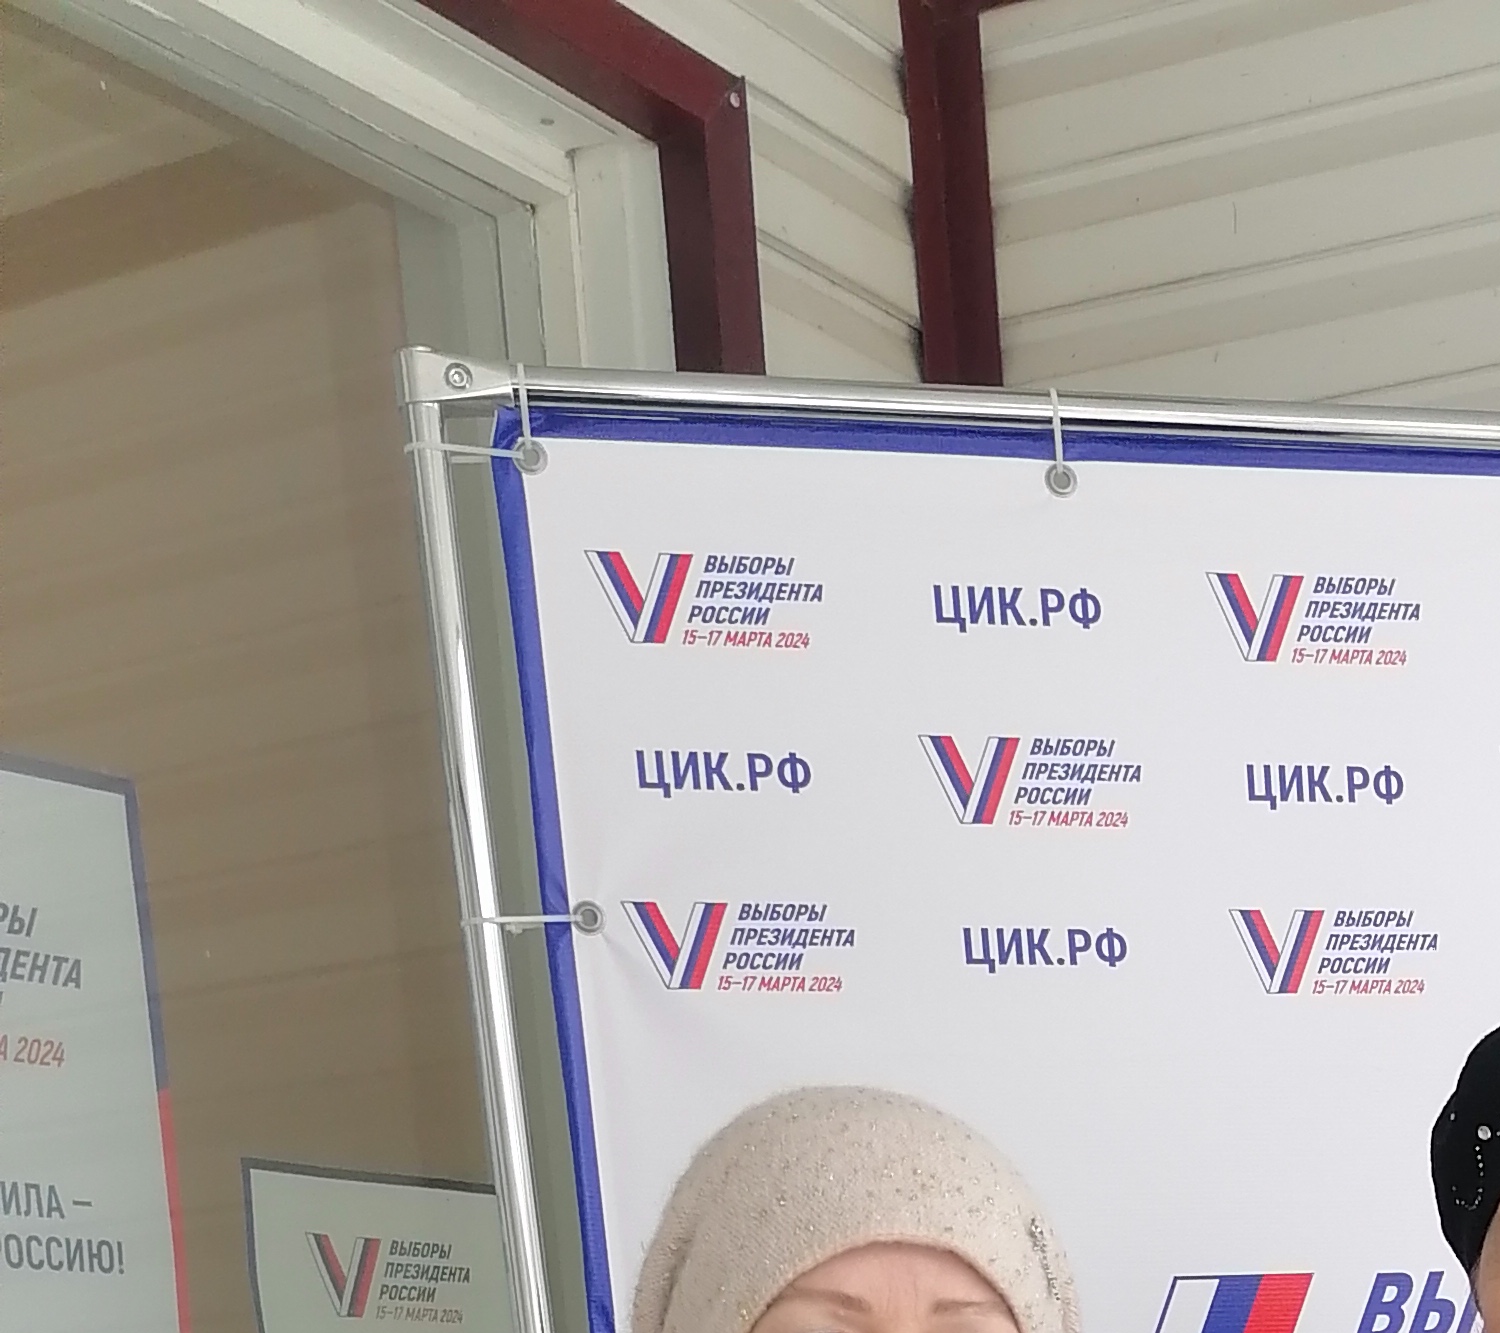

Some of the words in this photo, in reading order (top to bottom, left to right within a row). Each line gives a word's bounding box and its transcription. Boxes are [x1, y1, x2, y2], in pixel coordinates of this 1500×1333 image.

[704, 555, 794, 575] ВЫБОРЫ
[696, 580, 822, 603] ПРЕЗИДЕНТА
[1313, 577, 1395, 595] ВЫБОРЫ
[688, 605, 770, 625] РОССИИ
[933, 585, 1101, 633] ЦИК.РФ
[1305, 601, 1420, 622] ПРЕЗИДЕНТА
[724, 631, 772, 647] МАРТА
[775, 632, 809, 648] 2024
[1297, 625, 1372, 643] РОССИИ
[1329, 649, 1373, 664] МАРТА
[1375, 650, 1406, 665] 2024
[1030, 738, 1115, 757] ВЫБОРЫ
[636, 750, 811, 798] ЦИК.РФ
[1022, 763, 1141, 784] ПРЕЗИДЕНТА
[1014, 787, 1092, 805] РОССИИ
[1247, 764, 1403, 810] ЦИК.РФ
[1048, 811, 1093, 826] МАРТА
[1096, 812, 1128, 827] 2024
[738, 904, 827, 921] ВЫБОРЫ
[1334, 911, 1414, 927] ВЫБОРЫ
[730, 928, 854, 949] ПРЕЗИДЕНТА
[1326, 934, 1438, 953] ПРЕЗИДЕНТА
[963, 928, 1126, 973] ЦИК.РФ
[723, 953, 803, 970] РОССИИ
[1318, 957, 1390, 974] РОССИИ
[758, 976, 805, 991] МАРТА
[809, 977, 842, 992] 2024
[1349, 979, 1392, 994] МАРТА
[1394, 980, 1424, 994] 2024
[0, 1181, 65, 1219] ИЛА
[0, 1233, 125, 1275] ОССИЮ!
[389, 1240, 452, 1259] ВЫБОРЫ
[384, 1262, 470, 1283] ПРЕЗИДЕНТА
[379, 1284, 436, 1302] РОССИИ
[405, 1307, 438, 1321] МАРТА
[440, 1309, 463, 1323] 2024
